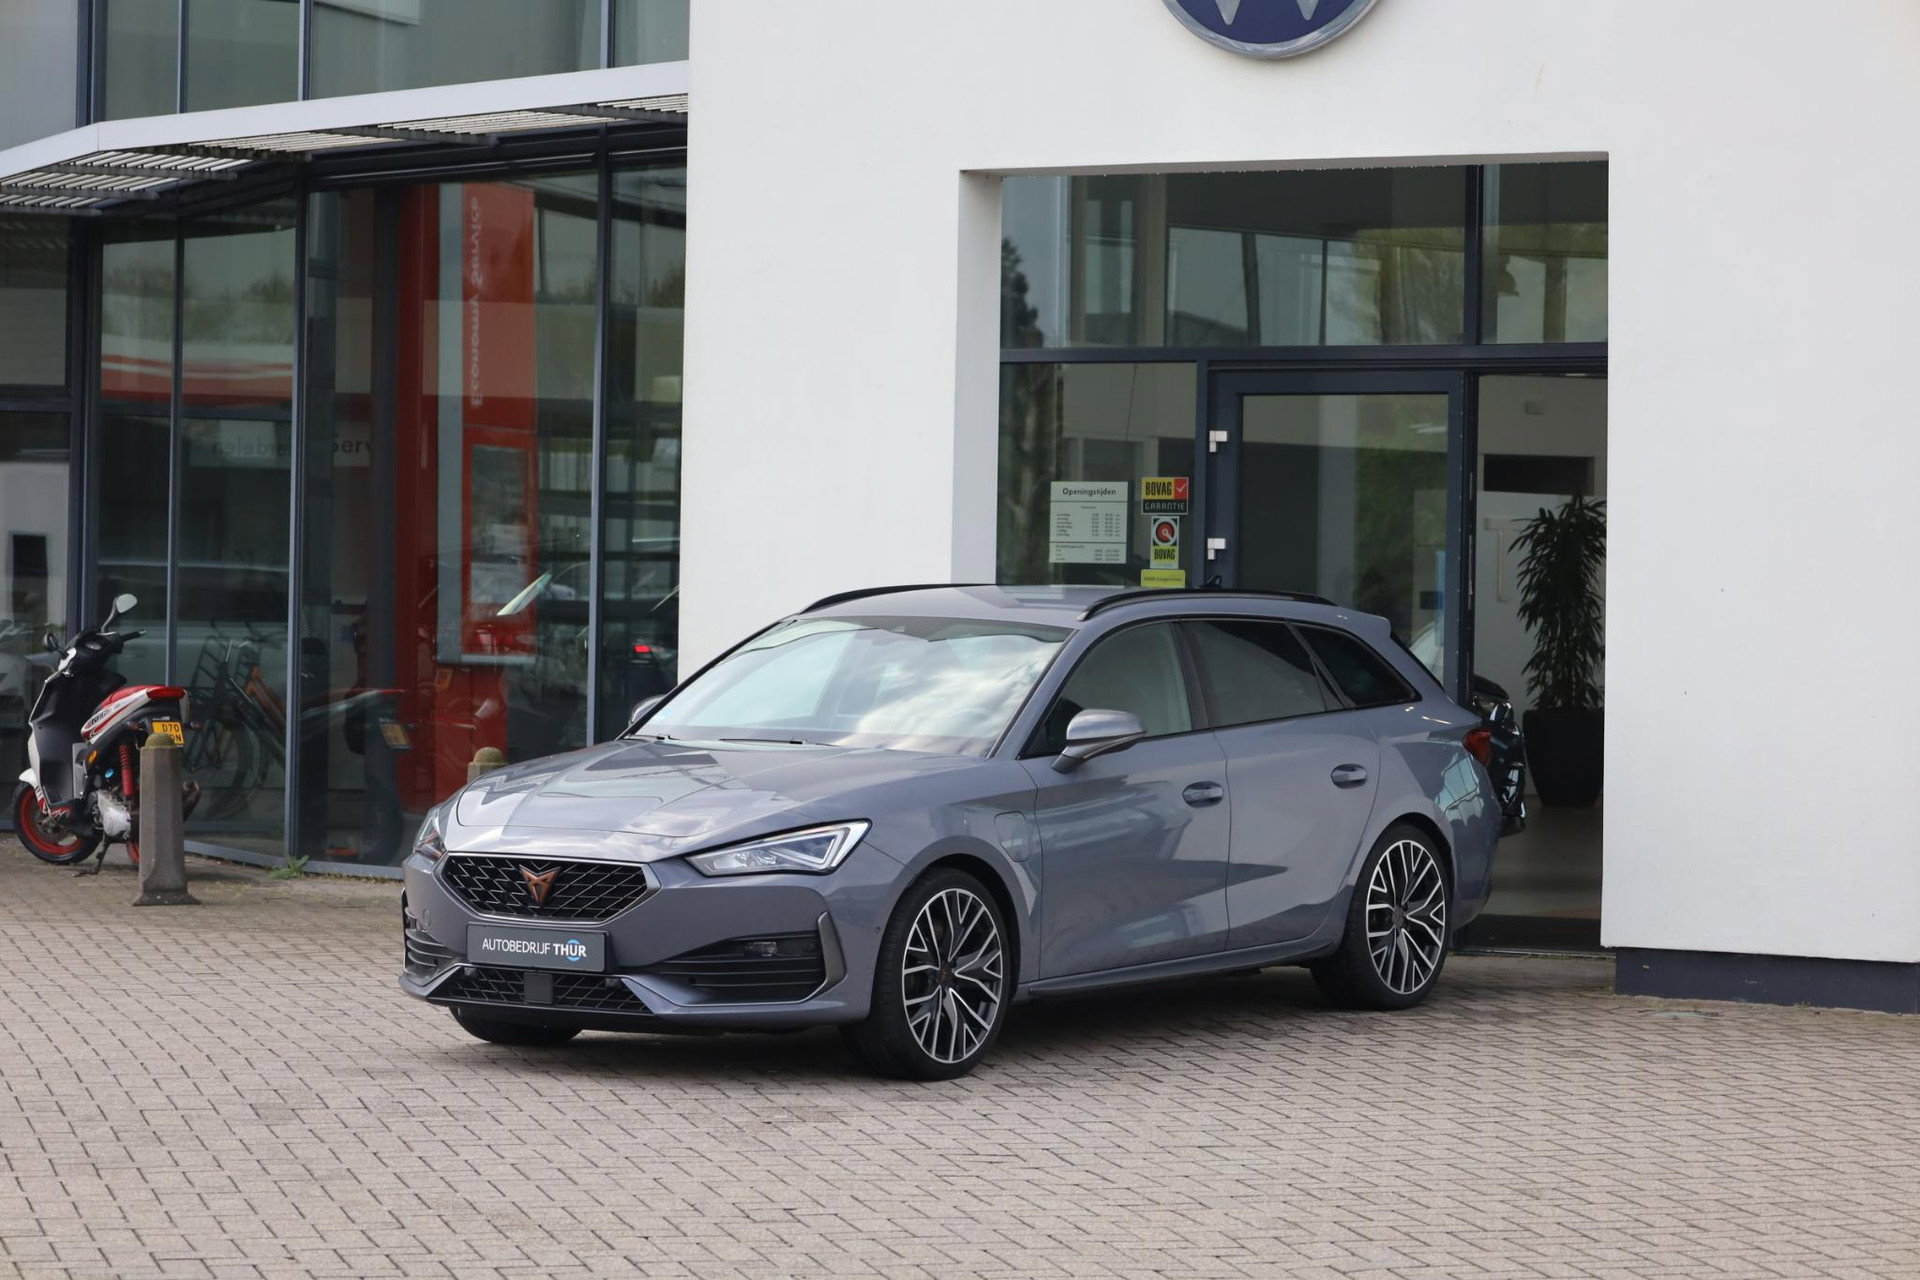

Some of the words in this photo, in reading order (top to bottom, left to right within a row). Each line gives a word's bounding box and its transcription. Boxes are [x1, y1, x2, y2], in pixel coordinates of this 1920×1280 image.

[1062, 487, 1116, 497] Openingstijden
[1145, 481, 1172, 495] BOVAG
[1144, 502, 1185, 511] GARANTIE
[1154, 548, 1176, 560] BOVAG
[482, 938, 551, 955] AUTOBEDRIJF
[552, 942, 587, 958] THUR
